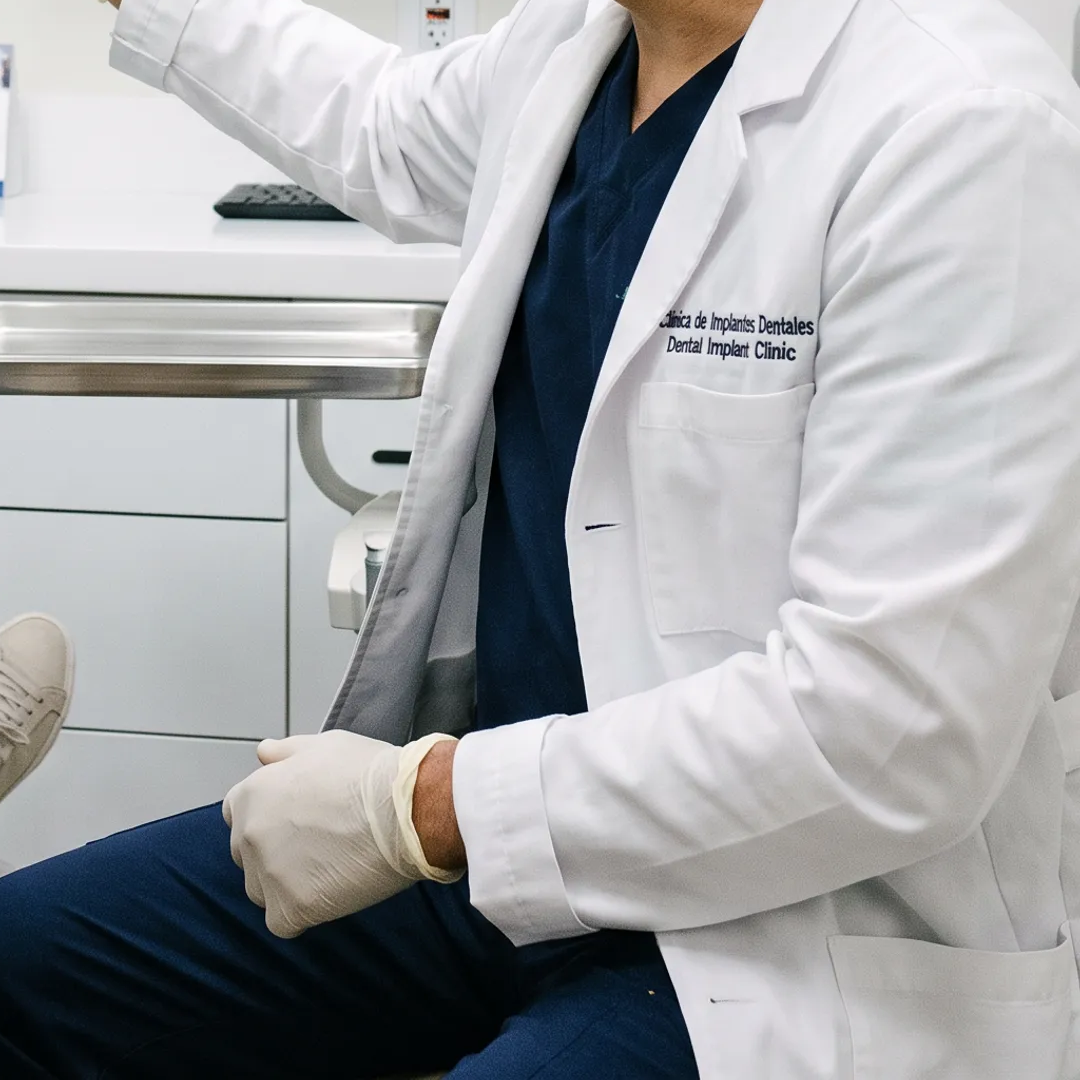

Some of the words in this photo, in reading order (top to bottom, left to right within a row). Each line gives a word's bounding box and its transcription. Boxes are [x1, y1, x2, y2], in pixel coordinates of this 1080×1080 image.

[694, 310, 708, 330] de
[710, 311, 756, 336] Implantes
[758, 314, 815, 336] Dentales
[666, 335, 703, 354] Dental
[706, 336, 750, 361] Implant
[754, 340, 797, 362] Clinic
